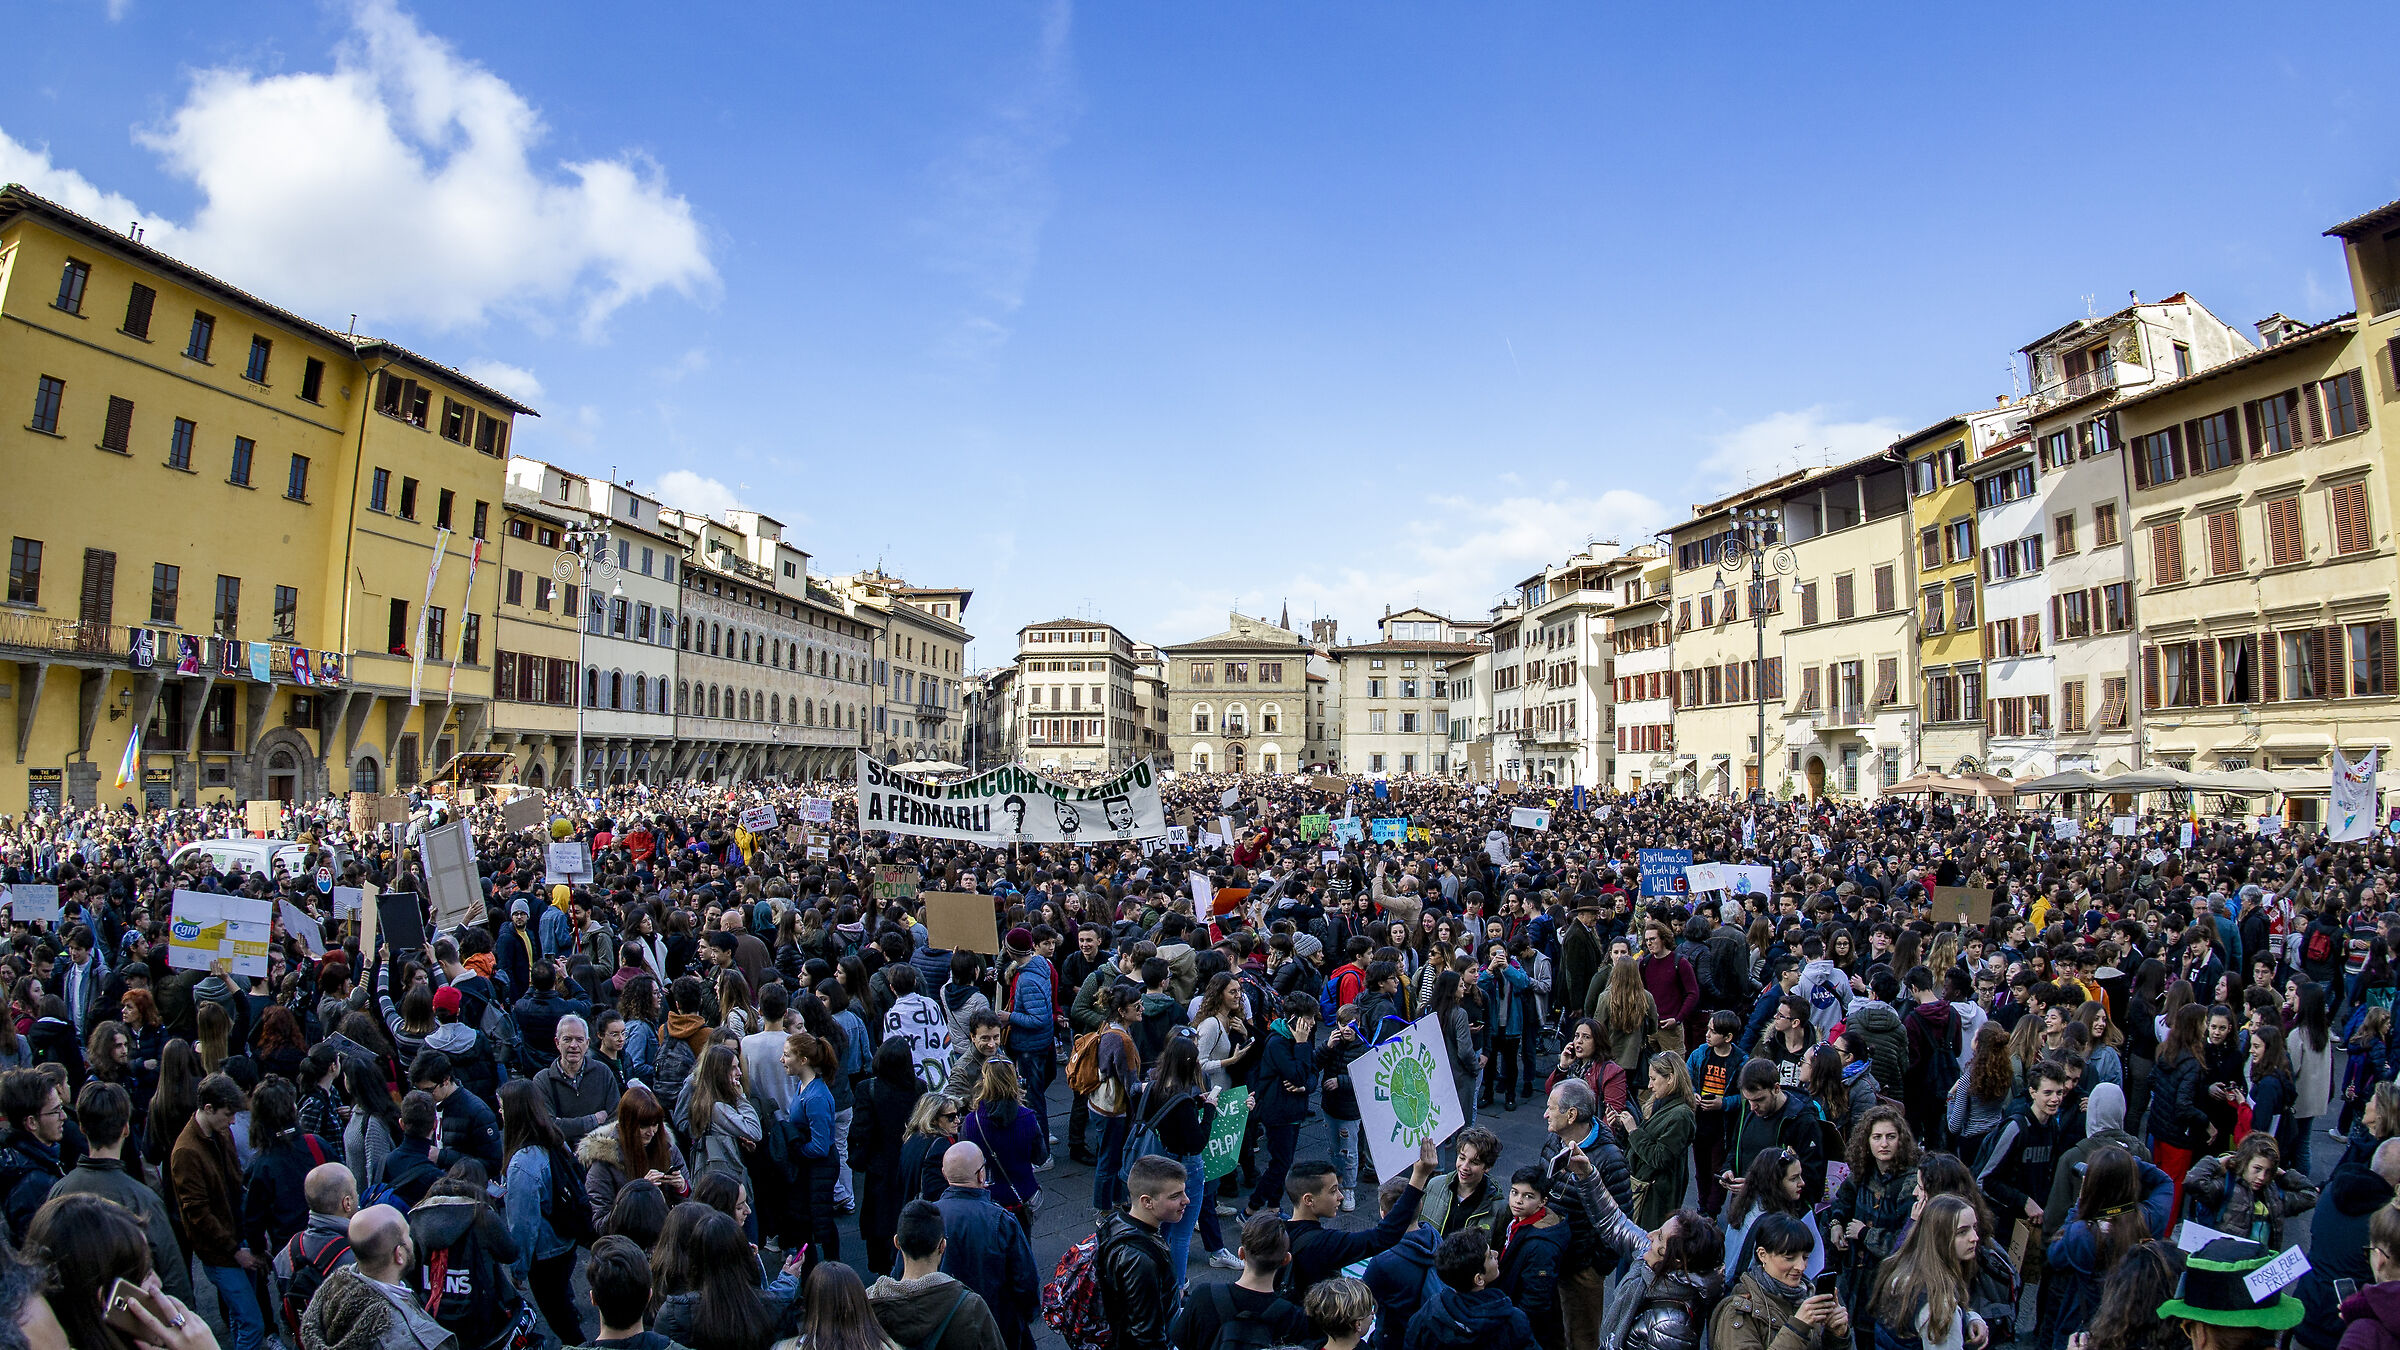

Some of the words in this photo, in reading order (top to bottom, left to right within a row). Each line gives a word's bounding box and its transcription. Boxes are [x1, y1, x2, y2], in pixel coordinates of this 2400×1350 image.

[868, 760, 941, 800] SIAMO
[948, 766, 1043, 800] ANCORA
[1044, 782, 1068, 802] IN
[1077, 761, 1151, 801] TEMPO
[351, 793, 363, 801] BLA
[355, 807, 373, 817] ACT
[868, 792, 882, 820] A
[888, 795, 990, 832] FERMARLI
[354, 816, 377, 831] NOW
[1170, 828, 1185, 841] OUR
[1146, 837, 1167, 854] IT'S
[1675, 852, 1688, 863] See
[1641, 863, 1652, 876] The
[1652, 864, 1669, 875] Earth
[174, 924, 198, 936] cgm
[924, 1028, 940, 1049] la
[1418, 1042, 1437, 1079] FOR
[1216, 1100, 1239, 1117] VE
[1390, 1101, 1441, 1149] FUTURE
[1208, 1131, 1241, 1158] PLAN
[2250, 1265, 2279, 1287] FOSSIL
[2278, 1251, 2303, 1271] FUEL
[422, 1264, 472, 1295] VNS
[2265, 1268, 2297, 1293] FREE
